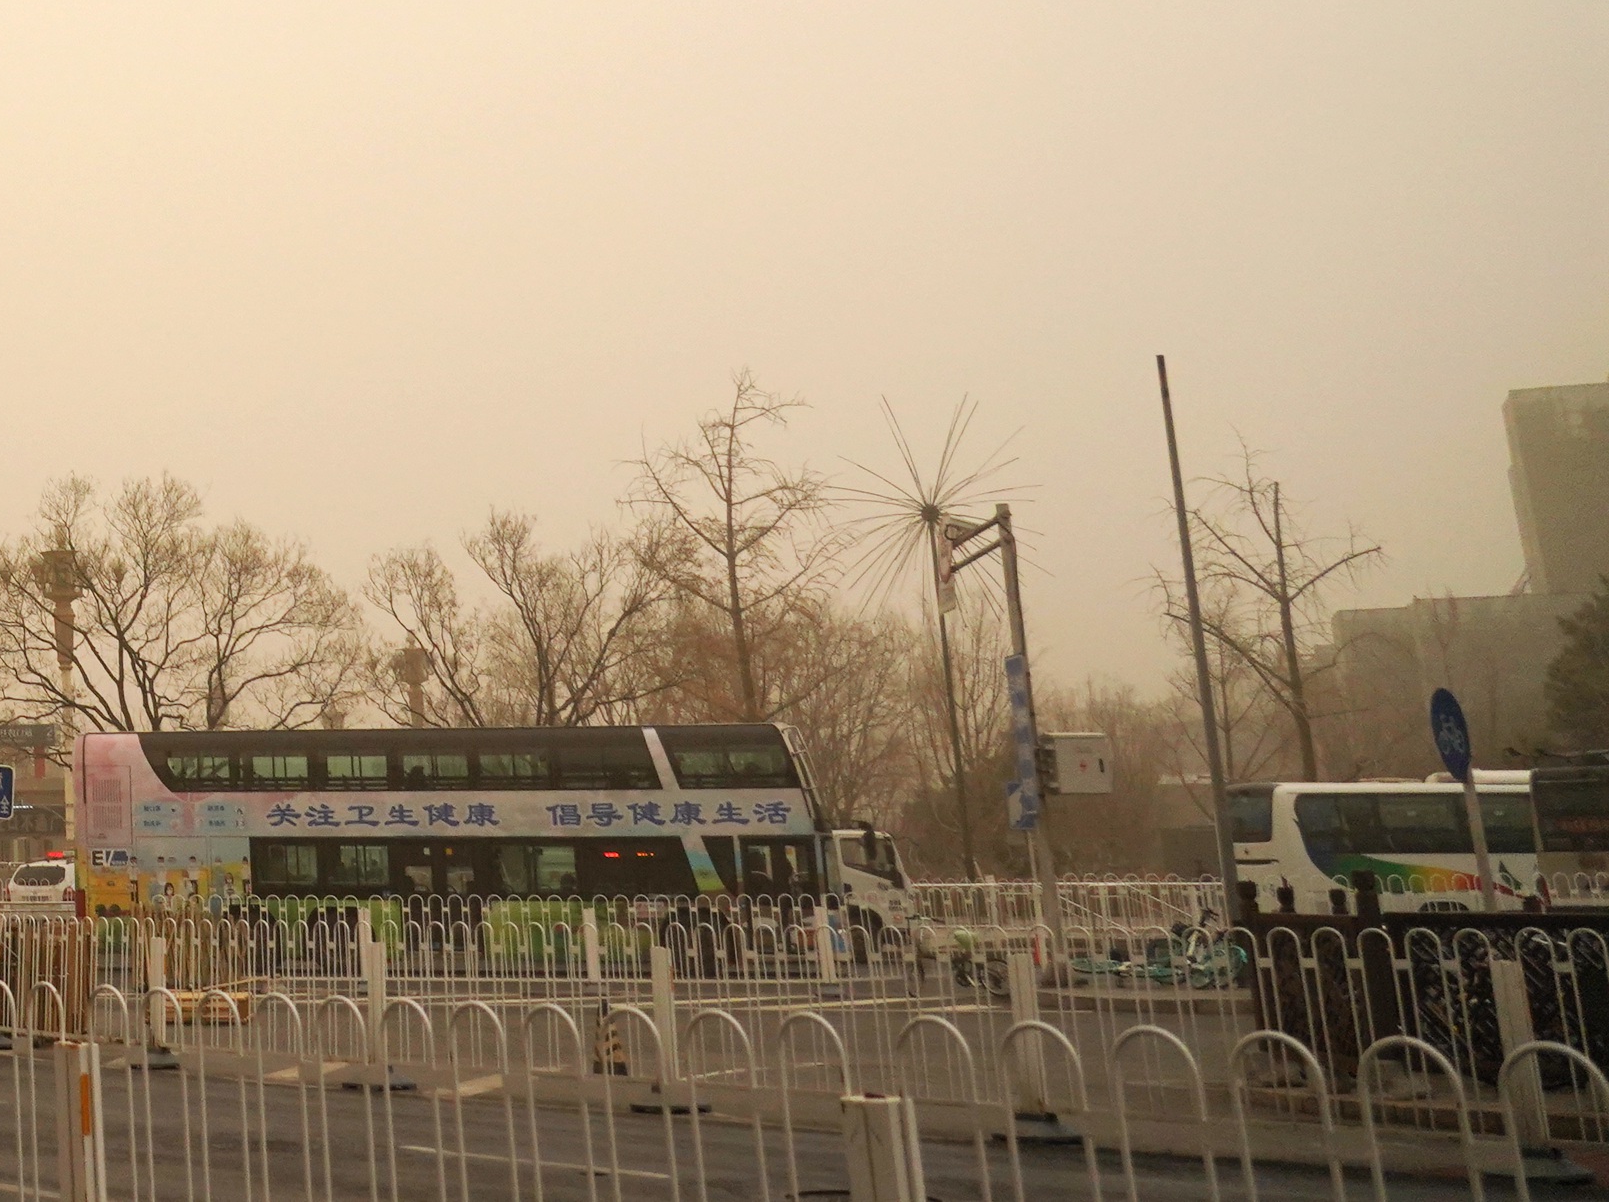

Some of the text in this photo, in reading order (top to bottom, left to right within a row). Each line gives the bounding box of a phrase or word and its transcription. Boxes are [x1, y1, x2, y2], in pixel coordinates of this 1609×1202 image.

[266, 800, 791, 827] 关注卫生健康 倡导健康生活
